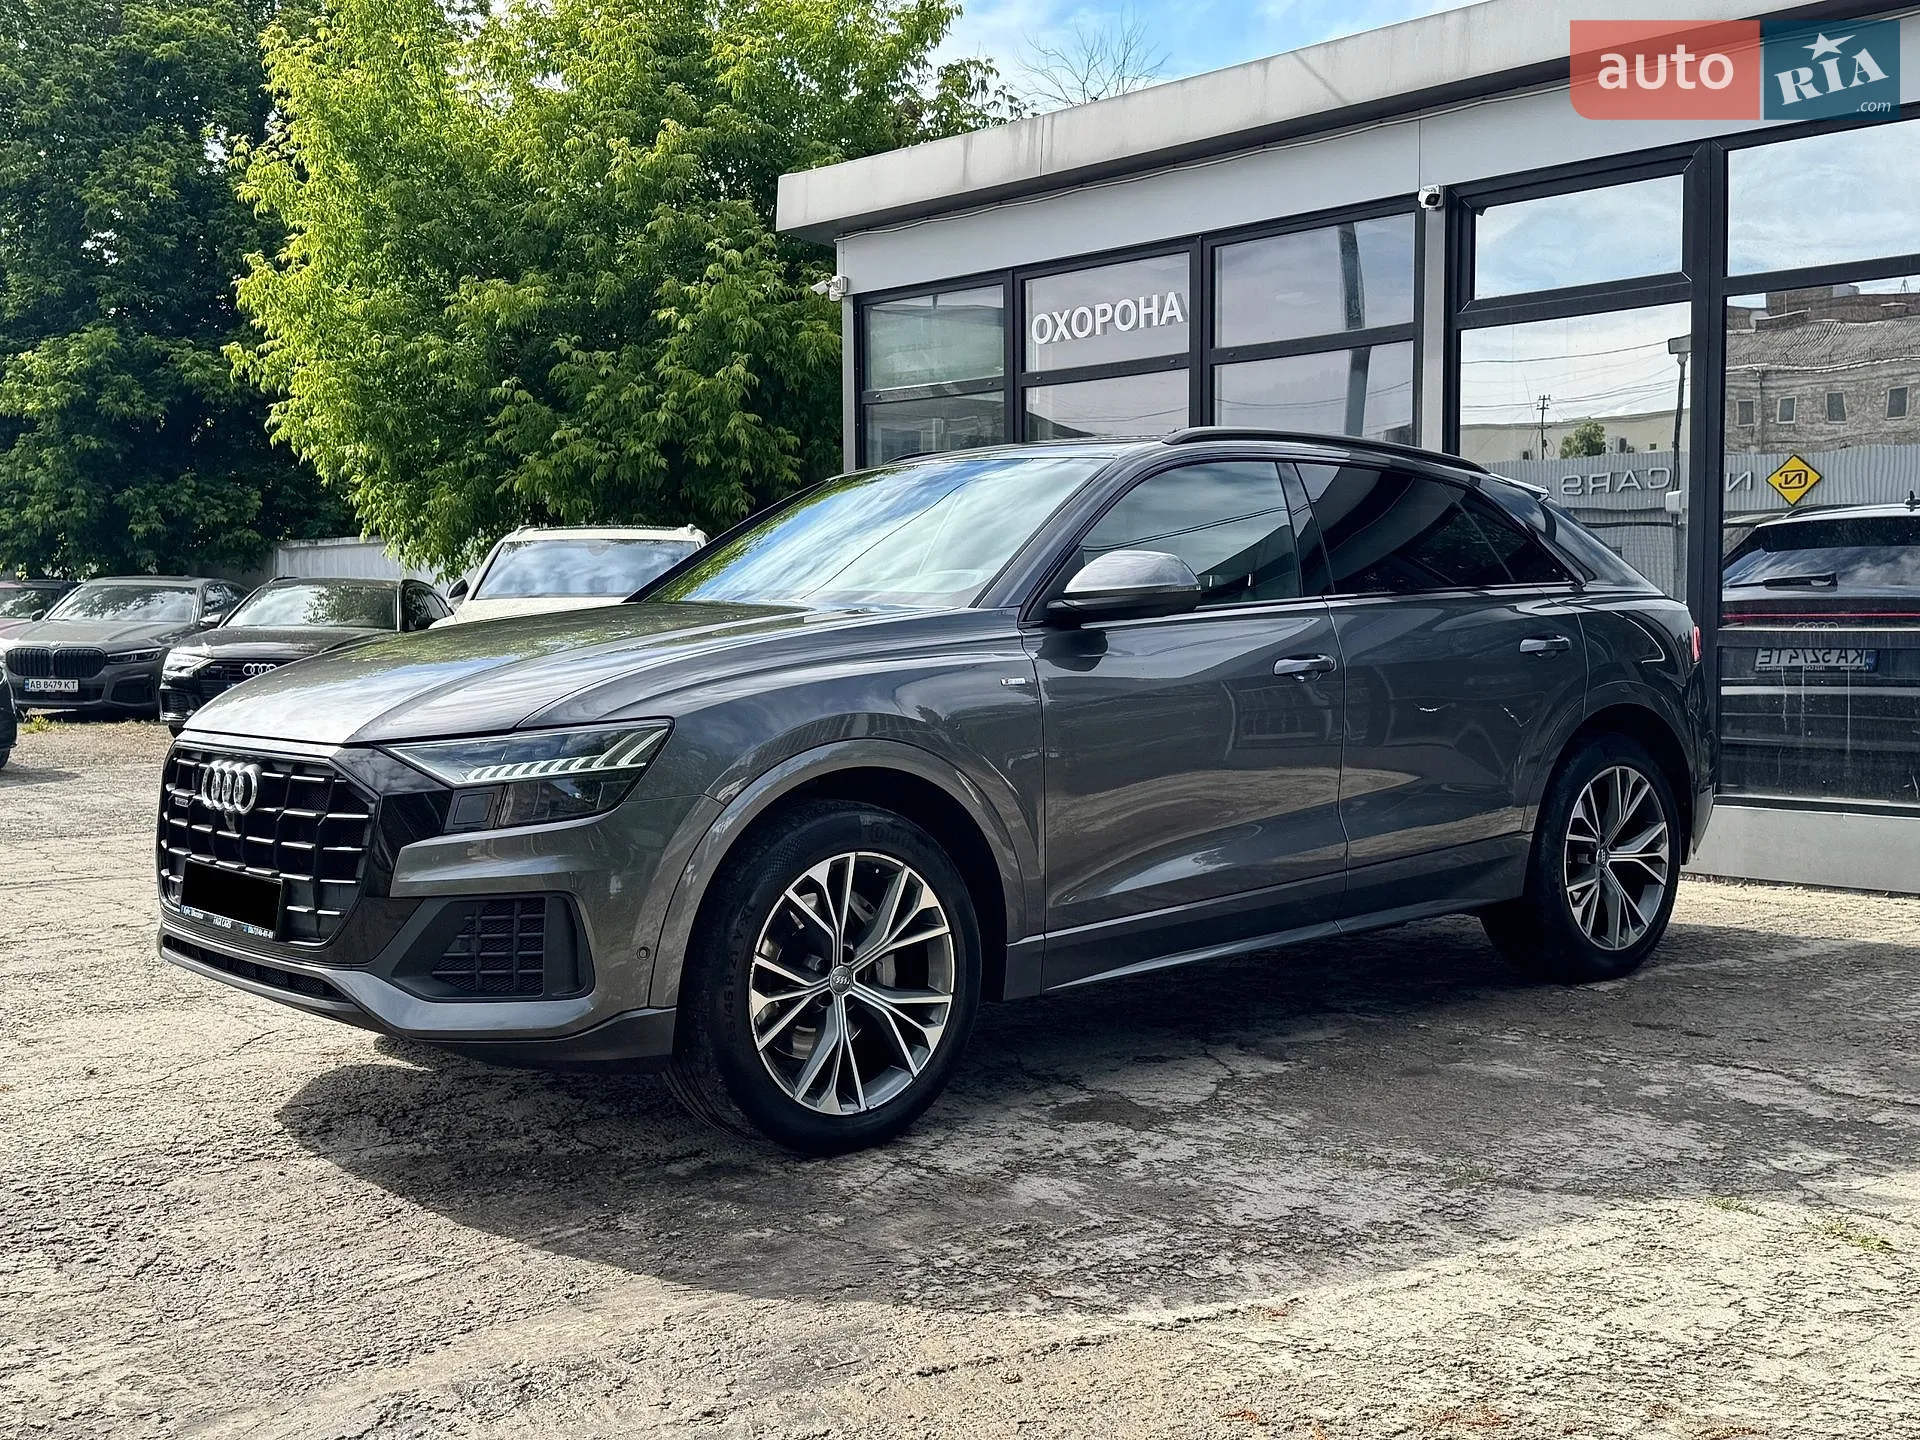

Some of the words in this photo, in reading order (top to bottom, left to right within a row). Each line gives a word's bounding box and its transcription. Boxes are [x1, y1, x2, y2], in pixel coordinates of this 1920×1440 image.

[1031, 291, 1185, 345] ОХОРОНА
[30, 681, 41, 689] AB
[64, 681, 76, 689] KT
